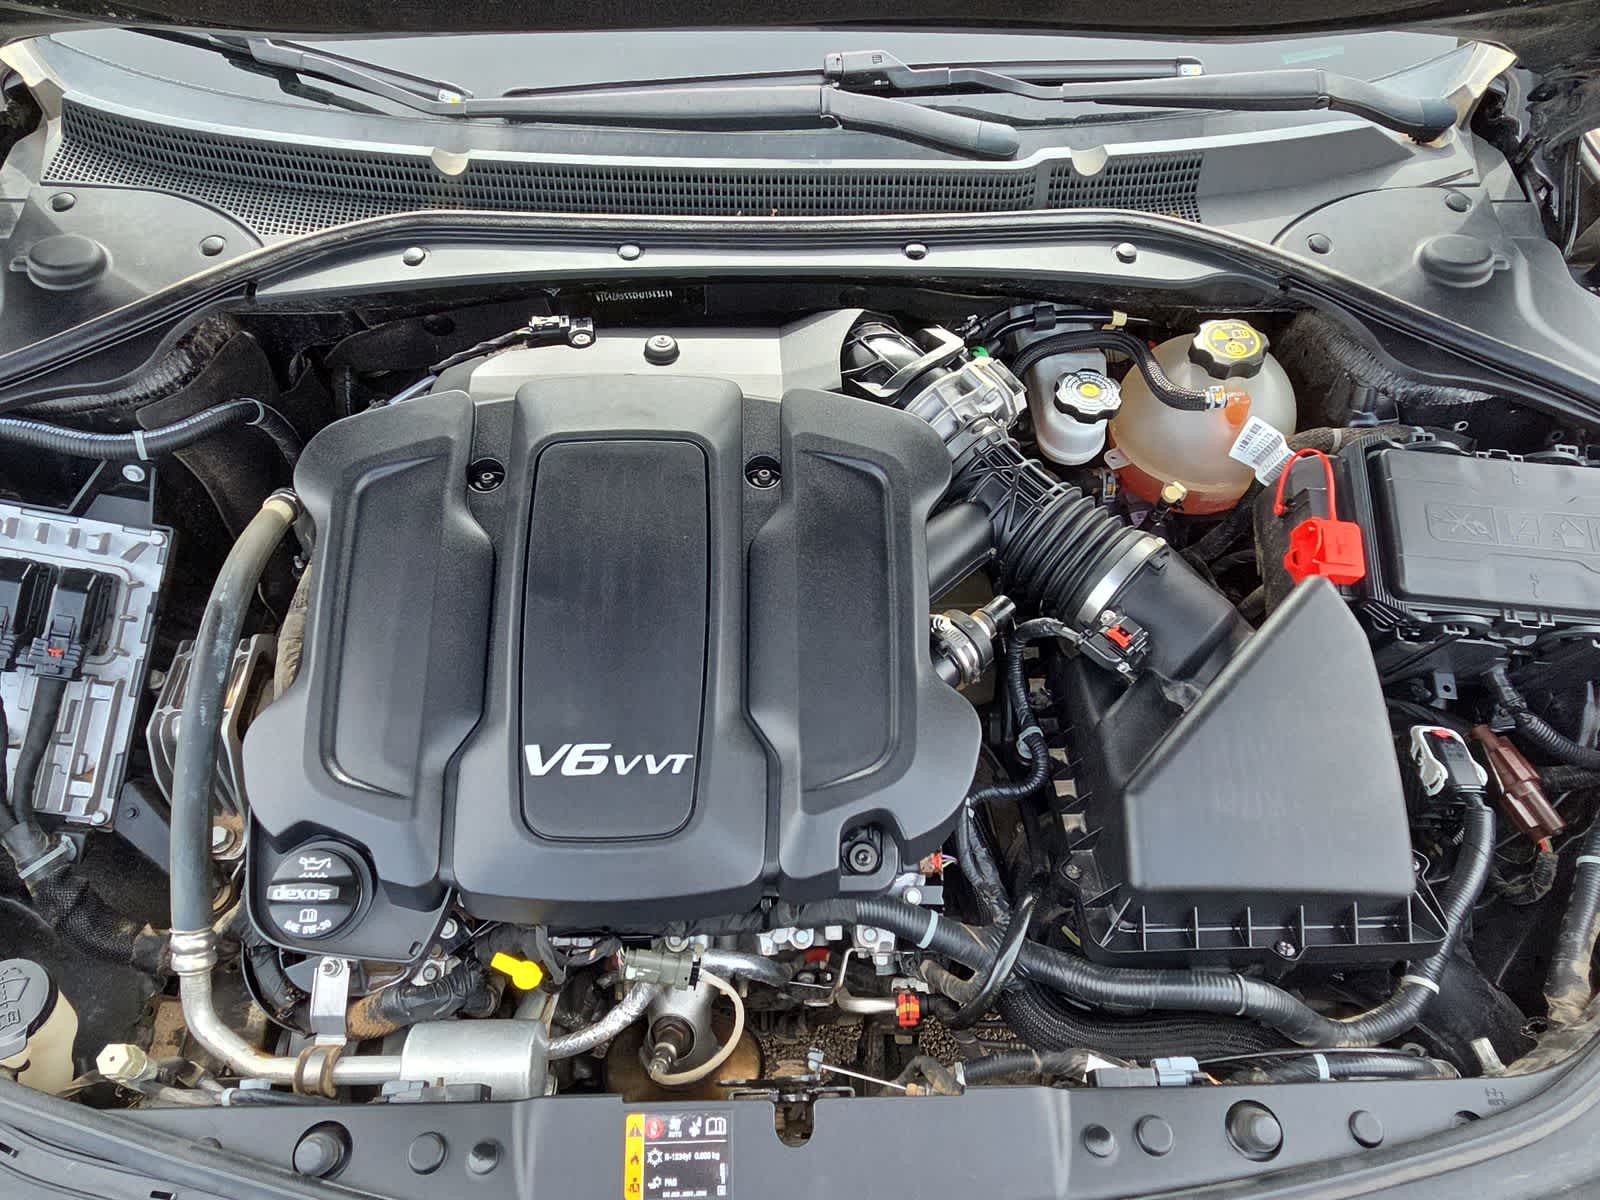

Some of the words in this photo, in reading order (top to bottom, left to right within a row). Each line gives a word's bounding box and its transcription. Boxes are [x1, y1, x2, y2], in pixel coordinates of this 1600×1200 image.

[524, 743, 612, 776] V6
[614, 754, 694, 776] VVT
[272, 885, 332, 901] dexos
